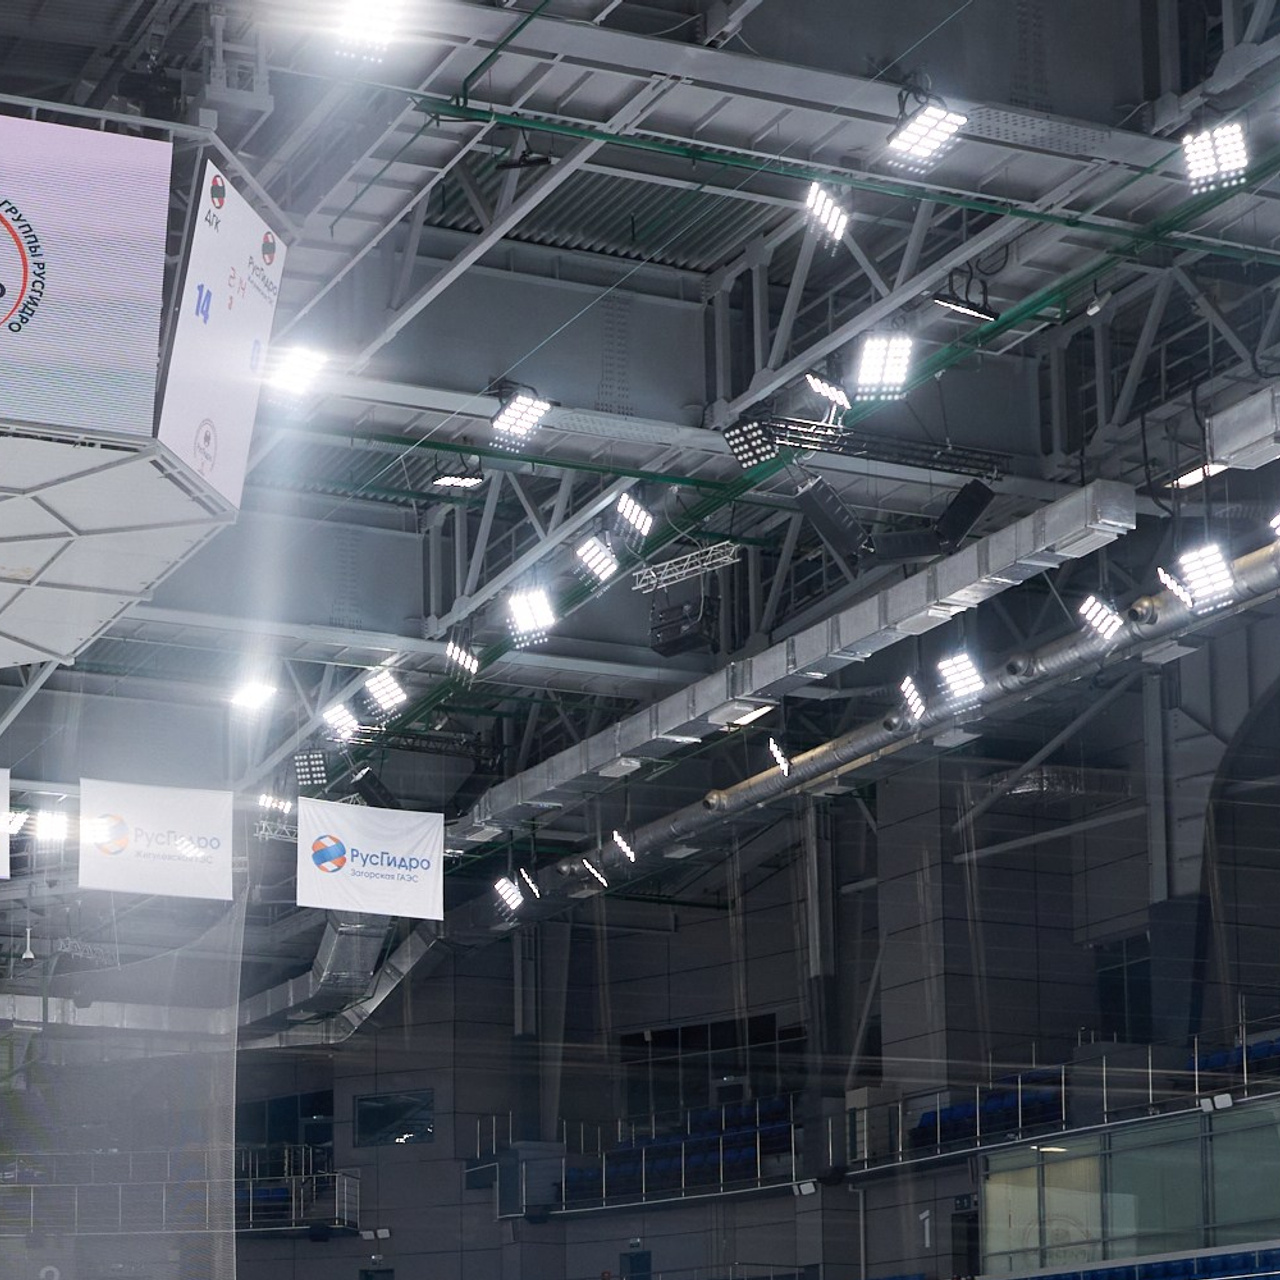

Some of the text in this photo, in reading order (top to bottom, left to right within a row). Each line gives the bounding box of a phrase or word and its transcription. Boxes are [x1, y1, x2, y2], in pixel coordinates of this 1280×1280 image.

[0, 198, 43, 258] ГРУППЫ
[8, 261, 45, 333] РУСГИДРО
[194, 283, 212, 325] 14
[350, 848, 431, 872] РусГидро
[350, 869, 419, 883] Загорская ГАЭС
[918, 1210, 930, 1248] 1
